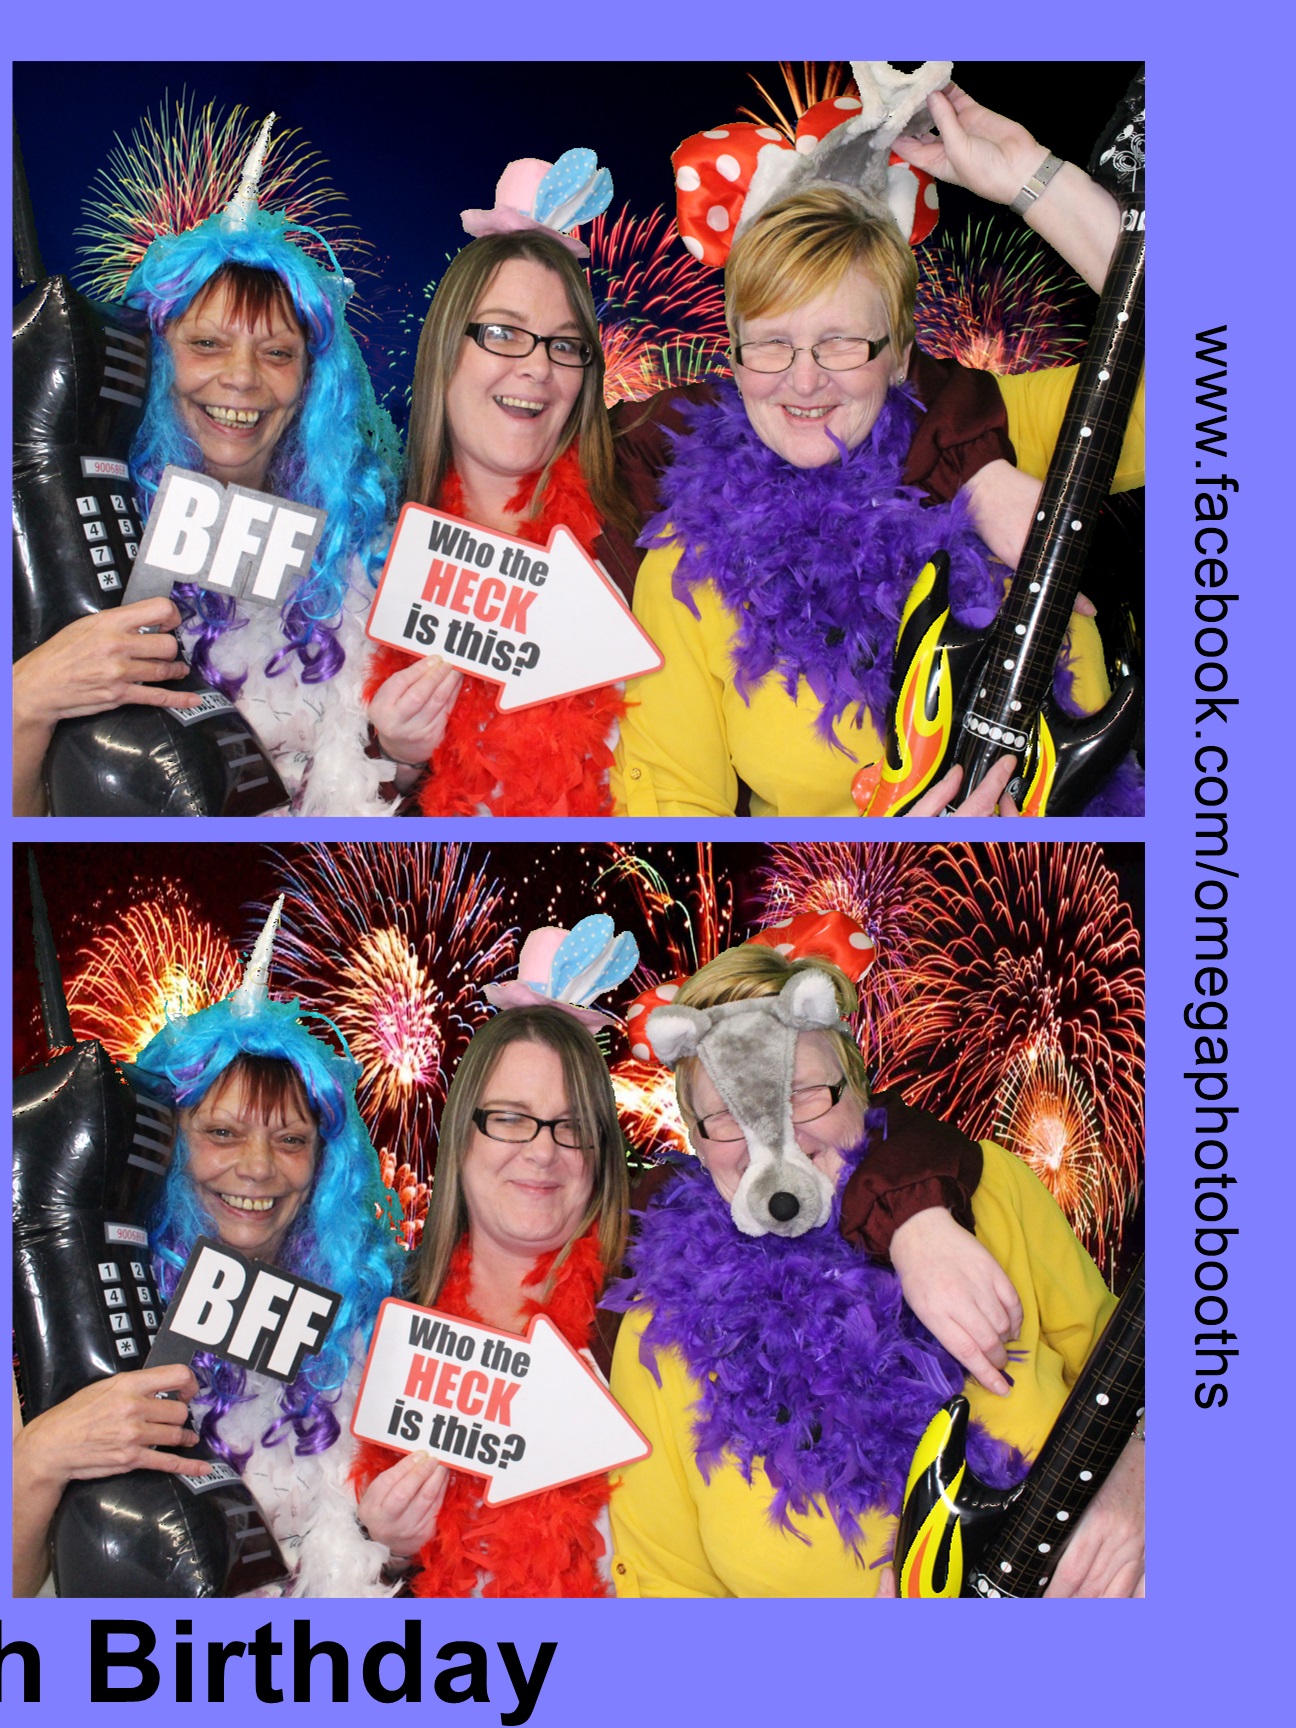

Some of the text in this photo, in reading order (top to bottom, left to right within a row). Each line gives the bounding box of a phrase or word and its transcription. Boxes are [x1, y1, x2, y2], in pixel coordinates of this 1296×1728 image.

[82, 497, 123, 511] 1 2
[89, 521, 131, 535] 4 5
[95, 545, 137, 561] 7 8
[144, 475, 316, 600] BFF
[428, 520, 549, 586] Who the
[421, 558, 538, 634] HECK
[403, 603, 540, 676] is this?
[104, 1264, 142, 1277] 1 2
[110, 1289, 149, 1302] 4 5
[115, 1313, 154, 1328] 7 8
[170, 1247, 332, 1376] BFF
[408, 1315, 530, 1377] Who the
[404, 1353, 520, 1426] HECK
[387, 1399, 526, 1469] is this?
